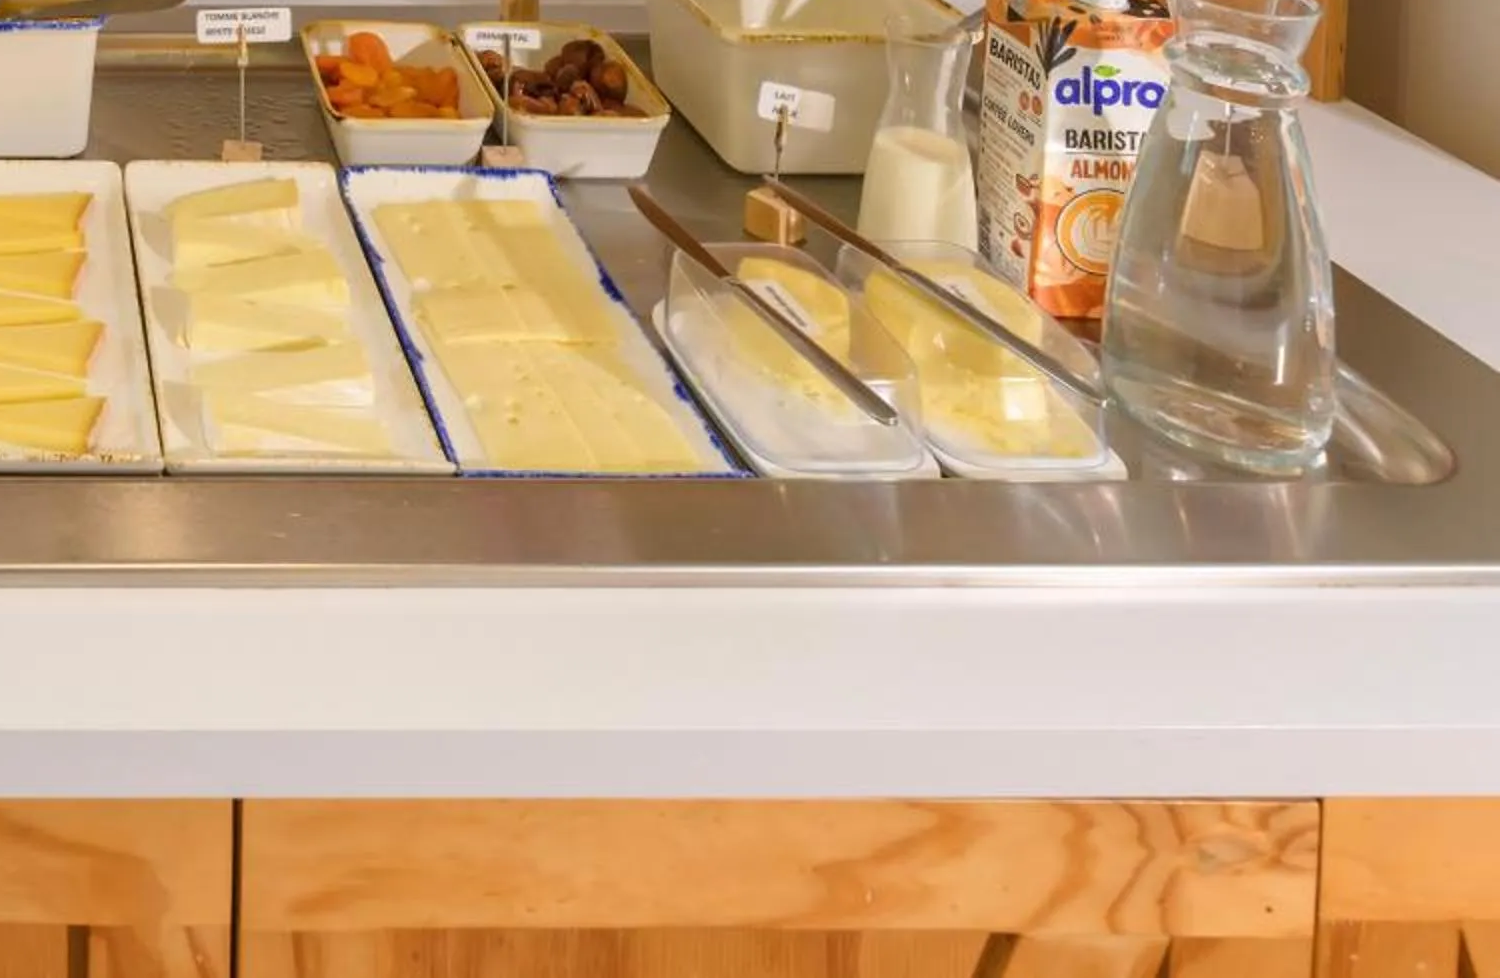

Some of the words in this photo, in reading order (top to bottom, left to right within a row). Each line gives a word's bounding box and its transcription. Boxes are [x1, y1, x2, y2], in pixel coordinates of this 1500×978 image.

[989, 37, 1041, 90] BARISTAS
[1055, 65, 1166, 115] alpro
[1071, 159, 1133, 181] ALMON
